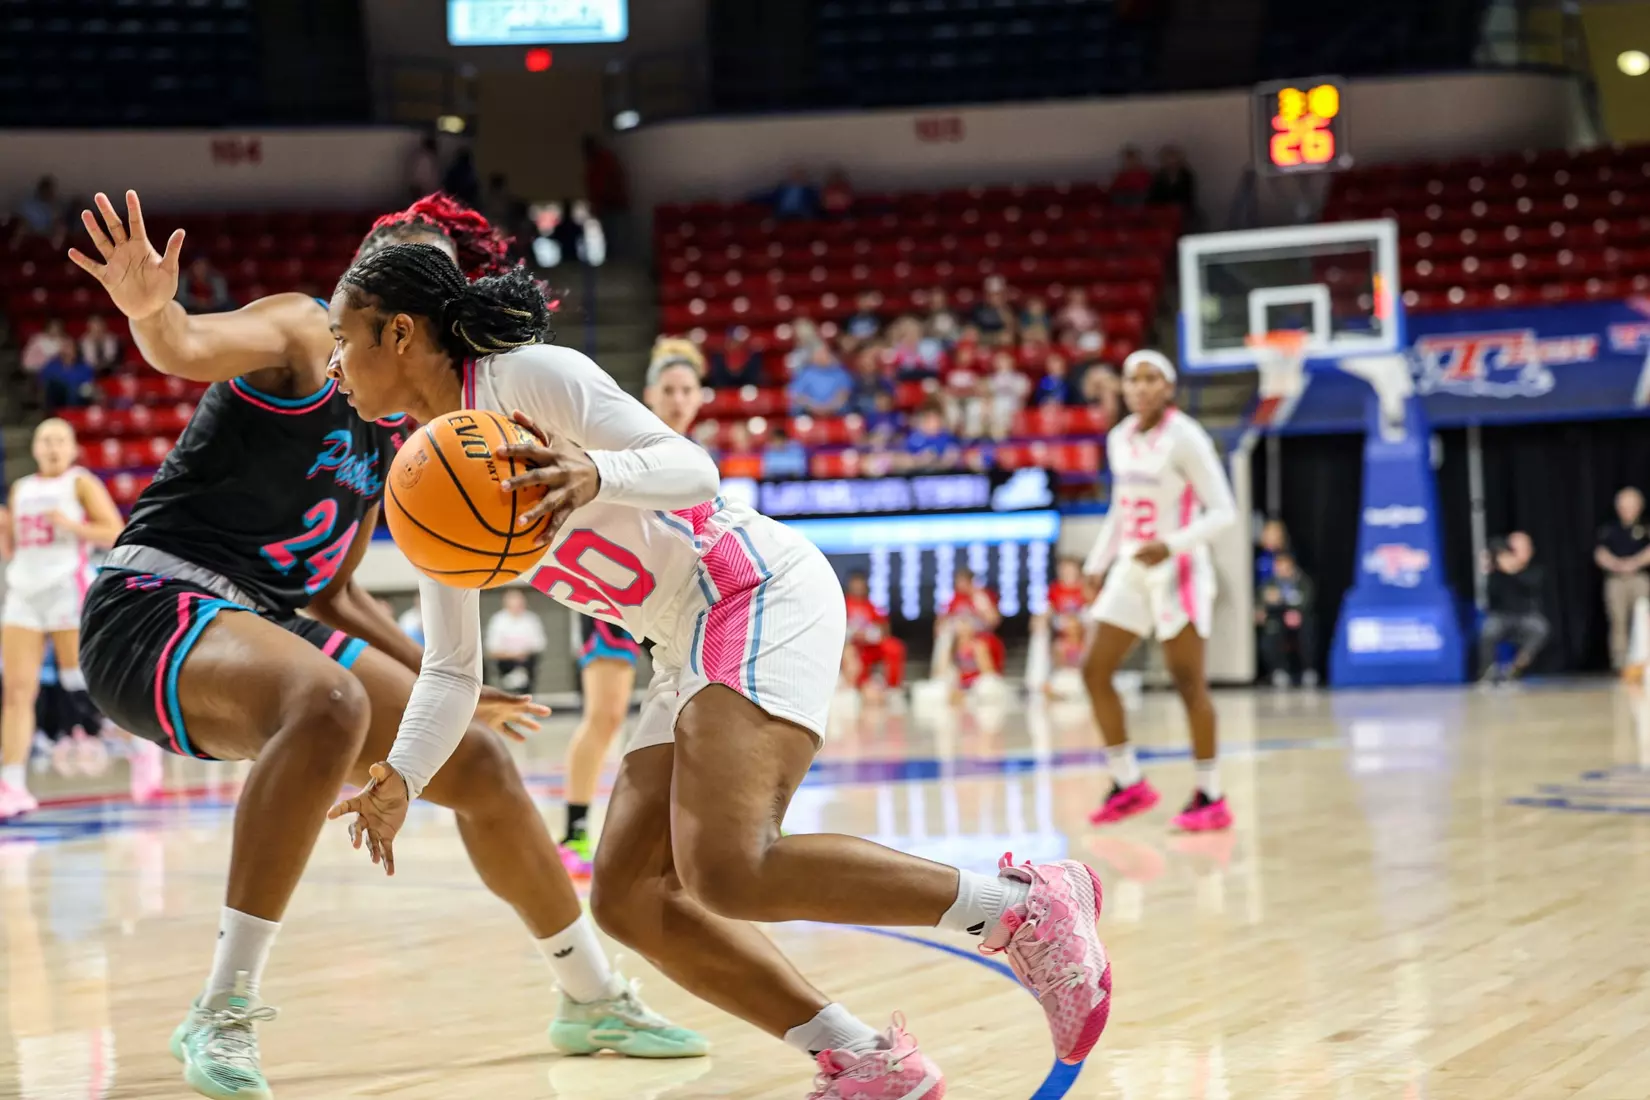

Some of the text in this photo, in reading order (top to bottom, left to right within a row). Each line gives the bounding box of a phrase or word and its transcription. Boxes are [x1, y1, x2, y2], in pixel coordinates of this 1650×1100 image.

[448, 415, 500, 483] EVO NXT
[529, 528, 657, 620] 30
